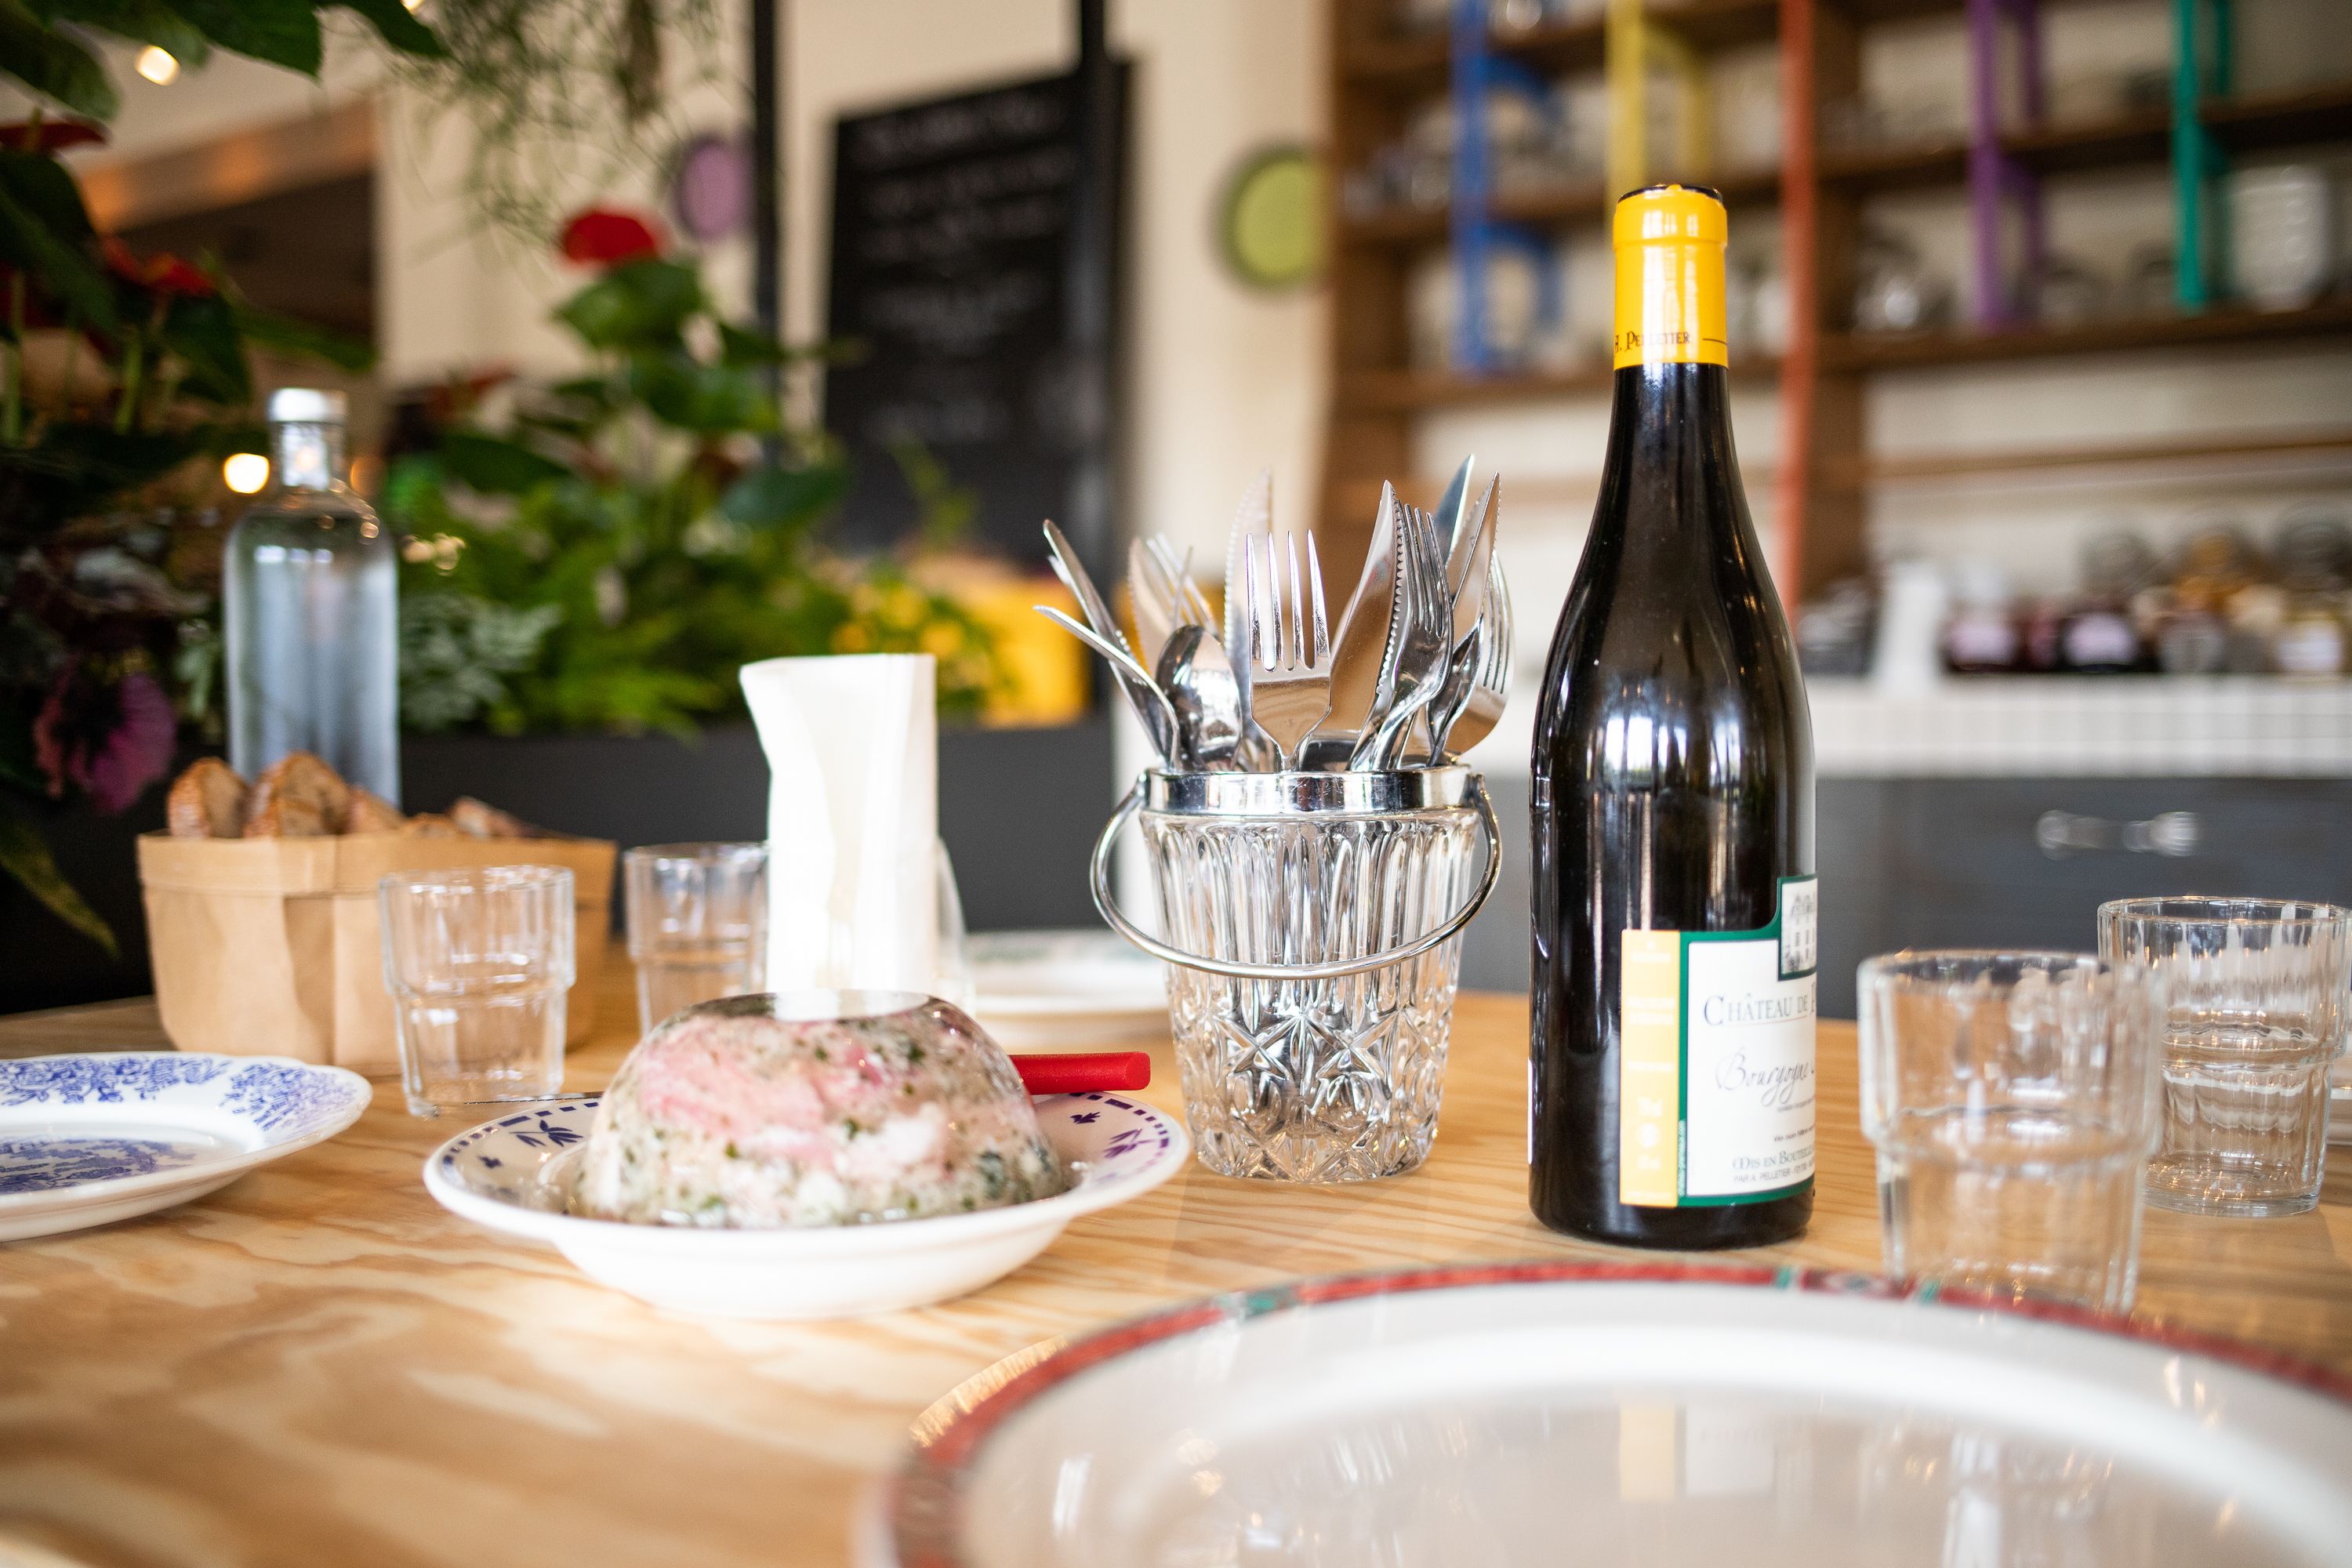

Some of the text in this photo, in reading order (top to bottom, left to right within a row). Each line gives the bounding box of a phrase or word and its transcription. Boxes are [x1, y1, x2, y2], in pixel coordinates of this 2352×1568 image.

[1704, 992, 1793, 1026] CHÂTEAU
[1797, 995, 1809, 1013] DE
[1715, 1045, 1809, 1106] Bourgogne
[1763, 1156, 1777, 1167] EN
